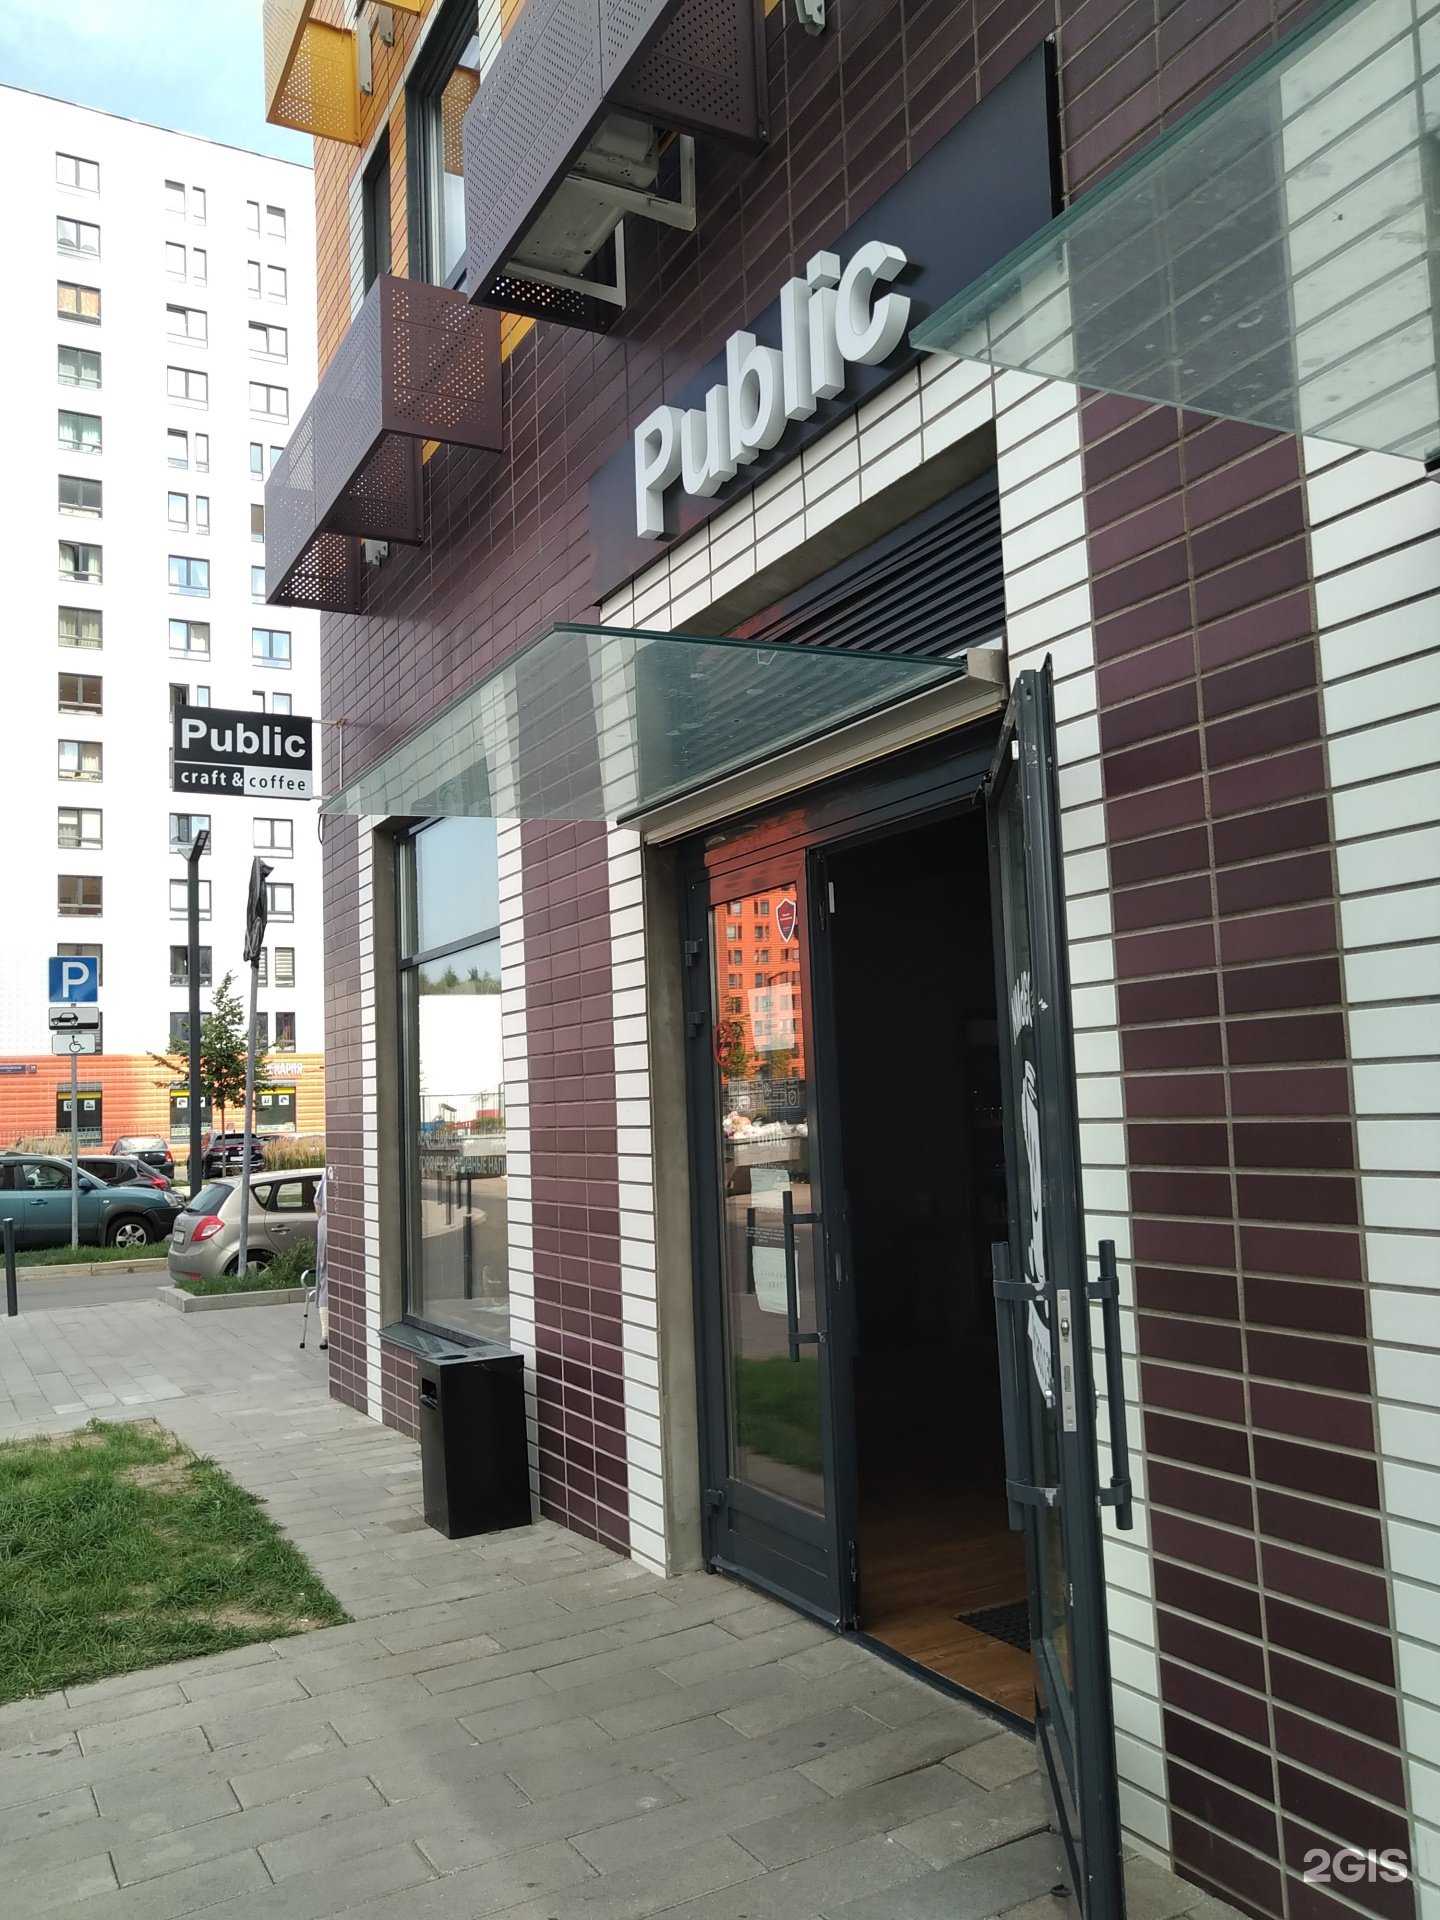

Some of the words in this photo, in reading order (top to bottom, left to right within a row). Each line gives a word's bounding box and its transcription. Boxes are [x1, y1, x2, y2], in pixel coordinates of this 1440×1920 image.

[634, 240, 911, 539] Public
[181, 718, 306, 758] Public
[181, 770, 227, 786] craft
[250, 775, 306, 790] coffee
[62, 961, 90, 998] P
